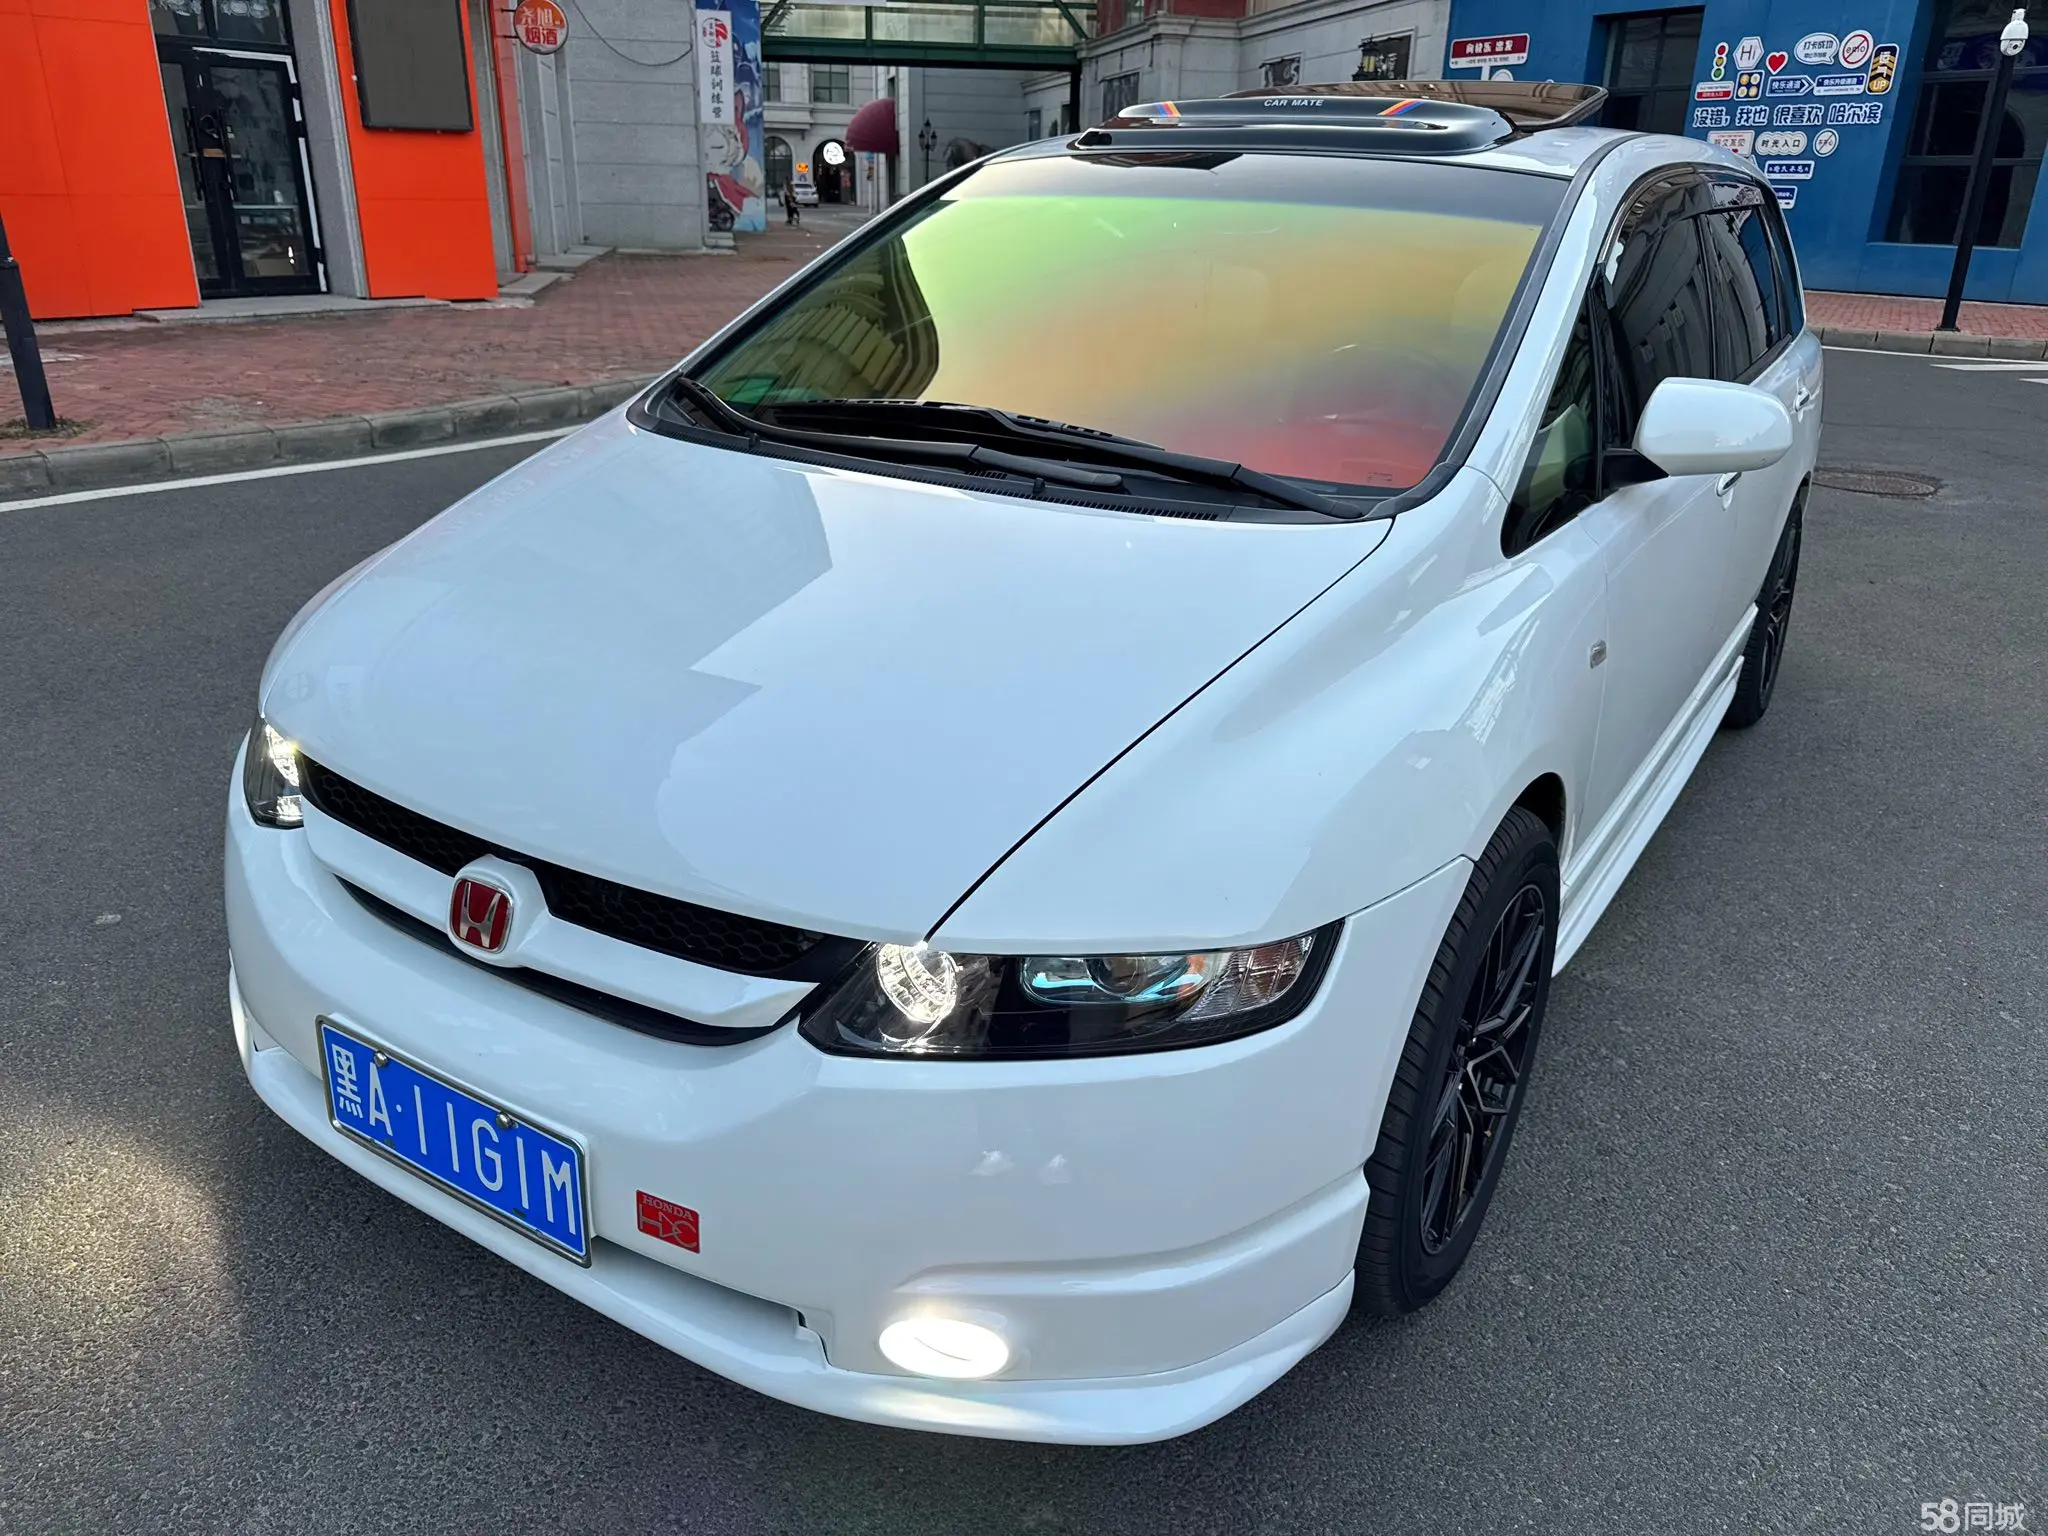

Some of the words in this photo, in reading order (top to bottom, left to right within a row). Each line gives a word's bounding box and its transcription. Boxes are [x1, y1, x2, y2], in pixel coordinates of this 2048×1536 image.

[525, 27, 558, 45] 烟酒
[1465, 41, 1492, 55] 向快乐
[1495, 39, 1514, 52] 出发
[1740, 45, 1757, 61] Hi
[1803, 40, 1834, 50] 打卡成功
[709, 50, 725, 119] 篮球训练营
[1771, 79, 1801, 90] 快乐通道
[1872, 80, 1886, 91] UP
[1263, 99, 1288, 107] CAR
[1291, 99, 1325, 107] MATE
[1774, 104, 1824, 126] 很喜欢
[1827, 102, 1883, 125] 哈尔滨
[1760, 139, 1802, 149] 时光入口
[642, 1194, 694, 1222] HONDA
